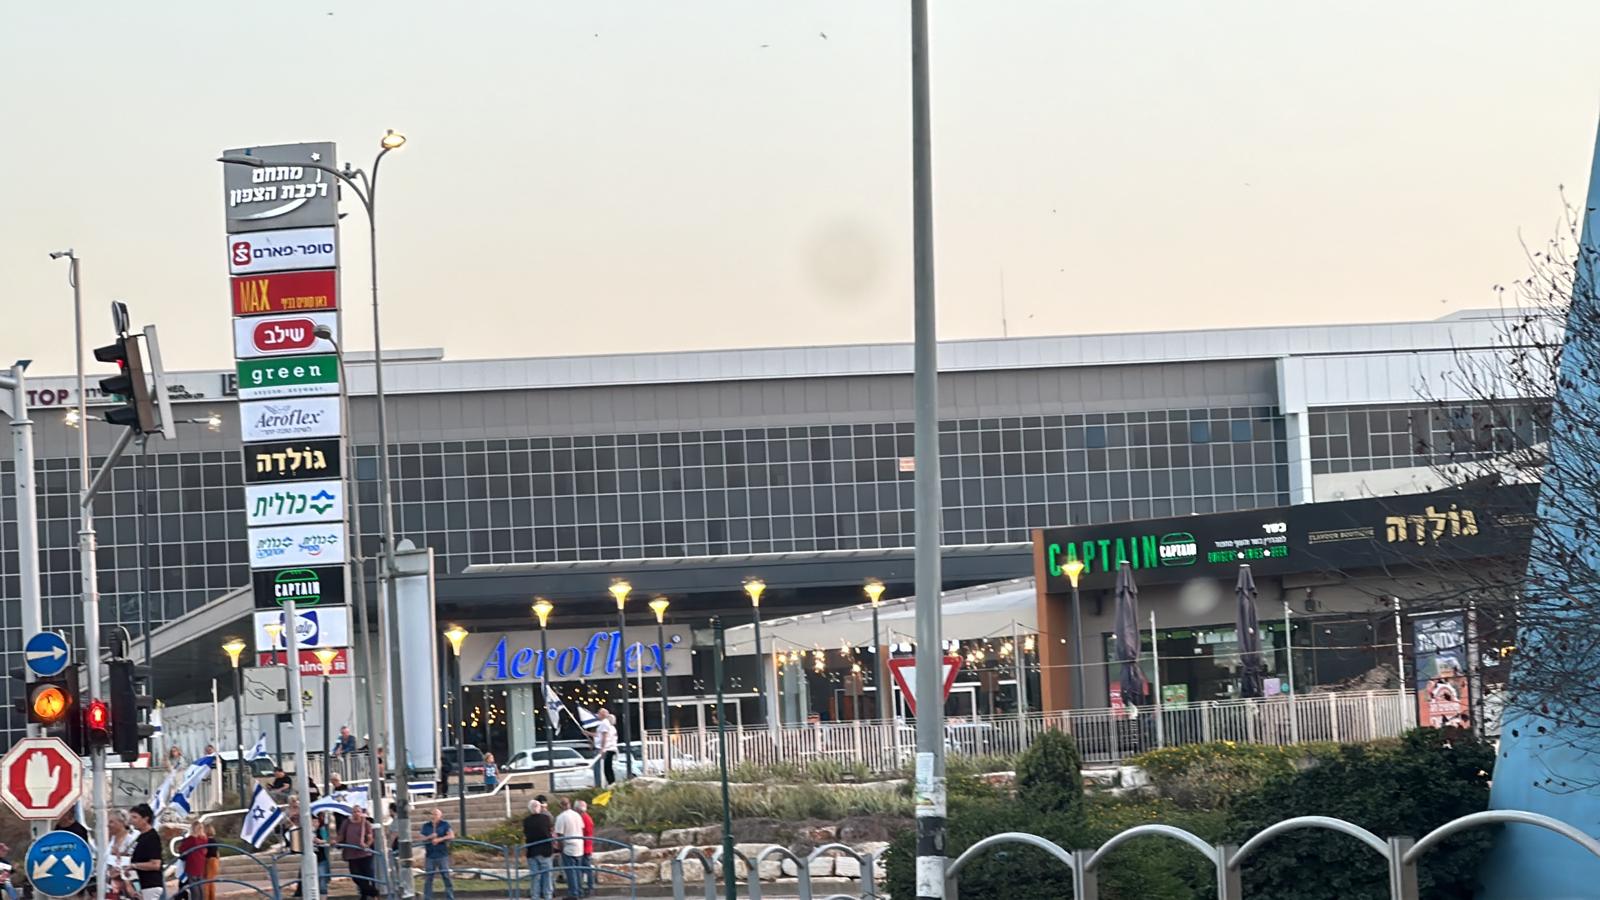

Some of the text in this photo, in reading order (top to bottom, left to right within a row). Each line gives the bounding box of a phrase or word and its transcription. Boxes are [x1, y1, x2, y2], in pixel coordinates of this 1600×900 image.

[252, 166, 303, 183] מתחם
[230, 182, 328, 207] רכבת הצפון
[253, 243, 333, 258] סופר-פארם
[240, 279, 270, 312] MAX
[264, 325, 305, 344] שילב
[251, 365, 322, 384] green
[254, 409, 320, 428] Aeroflex
[252, 491, 307, 517] כללית
[1048, 535, 1158, 577] CAPTAIN
[1160, 543, 1197, 558] CAPTAIN
[274, 581, 320, 597] CAPTAIN
[472, 630, 674, 682] Aeroflex
